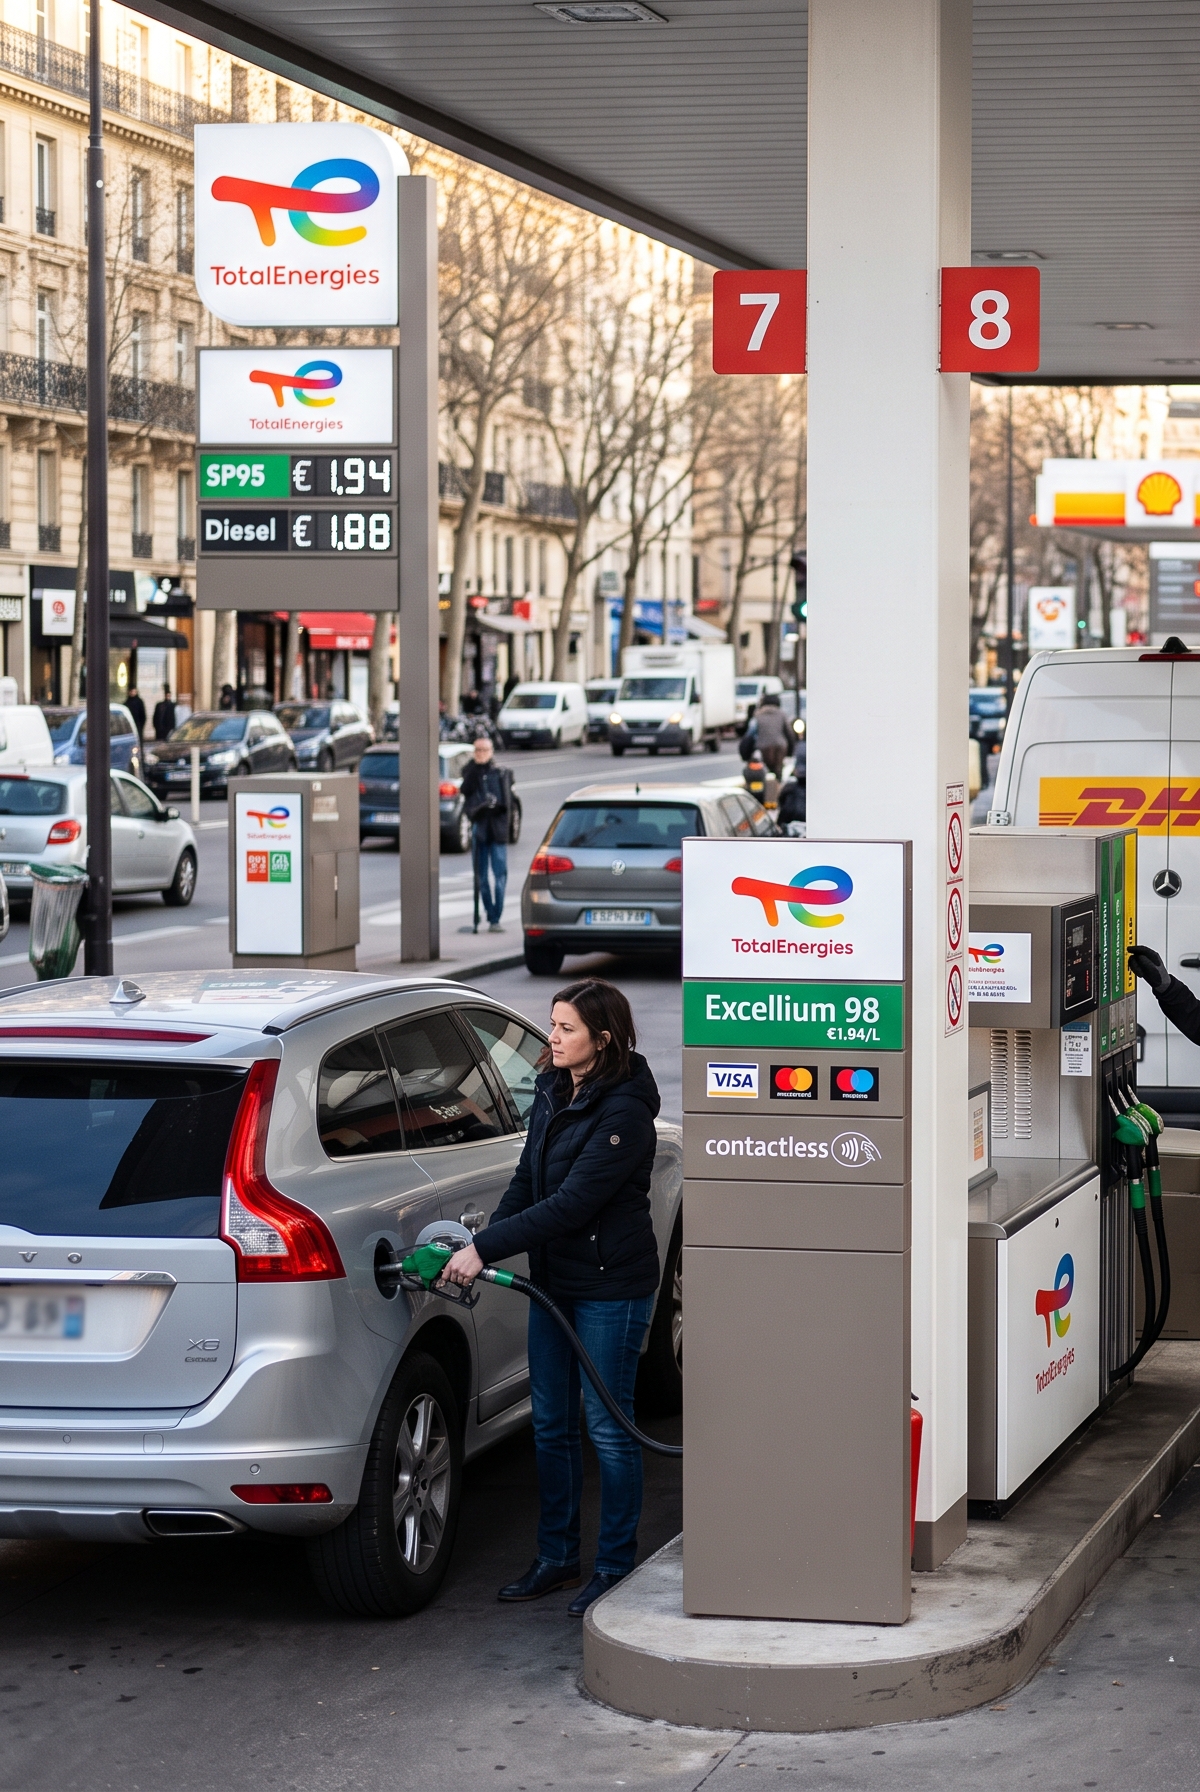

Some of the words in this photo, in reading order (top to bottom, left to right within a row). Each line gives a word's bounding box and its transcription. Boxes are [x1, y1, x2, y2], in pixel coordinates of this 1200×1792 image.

[210, 264, 380, 290] TotalEnergies
[739, 293, 780, 351] 7
[968, 290, 1012, 350] 8
[249, 418, 343, 433] TotalEnergies
[206, 463, 266, 487] SP95
[292, 460, 312, 492] €
[330, 458, 391, 496] 1.94
[205, 517, 276, 541] Diesel
[292, 515, 312, 547] €
[330, 513, 391, 550] 1.88
[731, 939, 854, 958] TotalEnergies
[706, 994, 836, 1023] Excellium
[844, 997, 880, 1023] 98
[826, 1027, 881, 1042] €1.94/L
[711, 1073, 753, 1088] VISA
[705, 1136, 829, 1158] contactless
